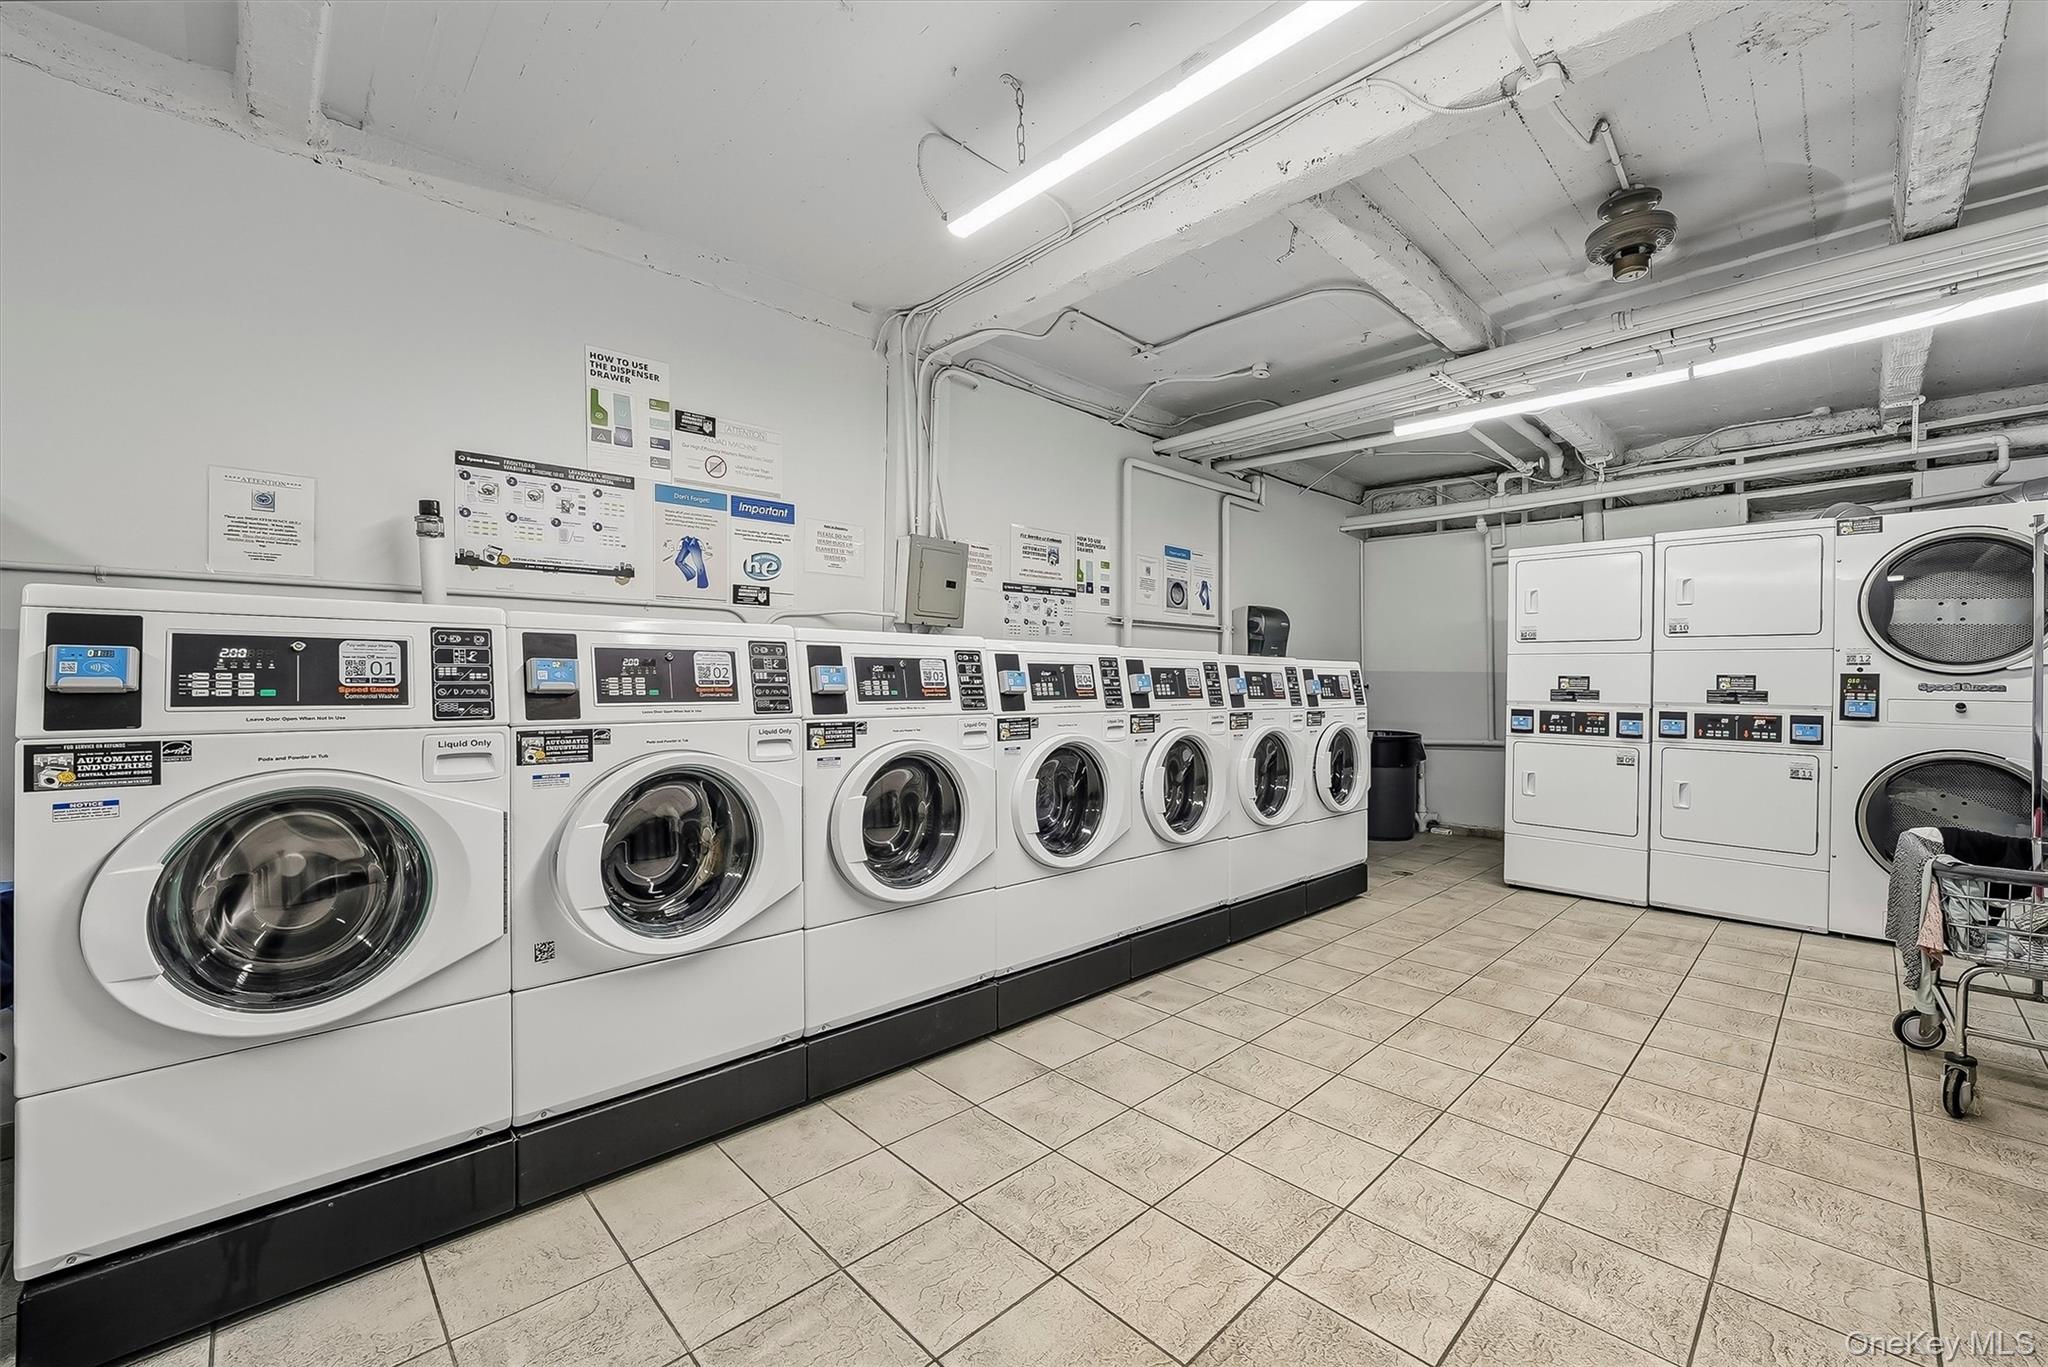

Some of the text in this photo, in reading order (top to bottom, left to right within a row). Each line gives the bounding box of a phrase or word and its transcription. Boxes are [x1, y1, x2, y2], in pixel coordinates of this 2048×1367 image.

[590, 352, 648, 371] HOW TO USE
[590, 360, 660, 382] THE DISPENSER
[590, 369, 631, 384] DRAWER
[738, 501, 788, 518] Important
[370, 661, 396, 676] 01
[713, 666, 729, 679] 02
[933, 671, 944, 681] 03
[1918, 682, 2007, 693] Speed Queen
[438, 739, 491, 749] Liquid Only
[77, 755, 153, 764] AUTOMATIC
[77, 762, 153, 772] INDUSTRIES
[1801, 769, 1813, 777] 11
